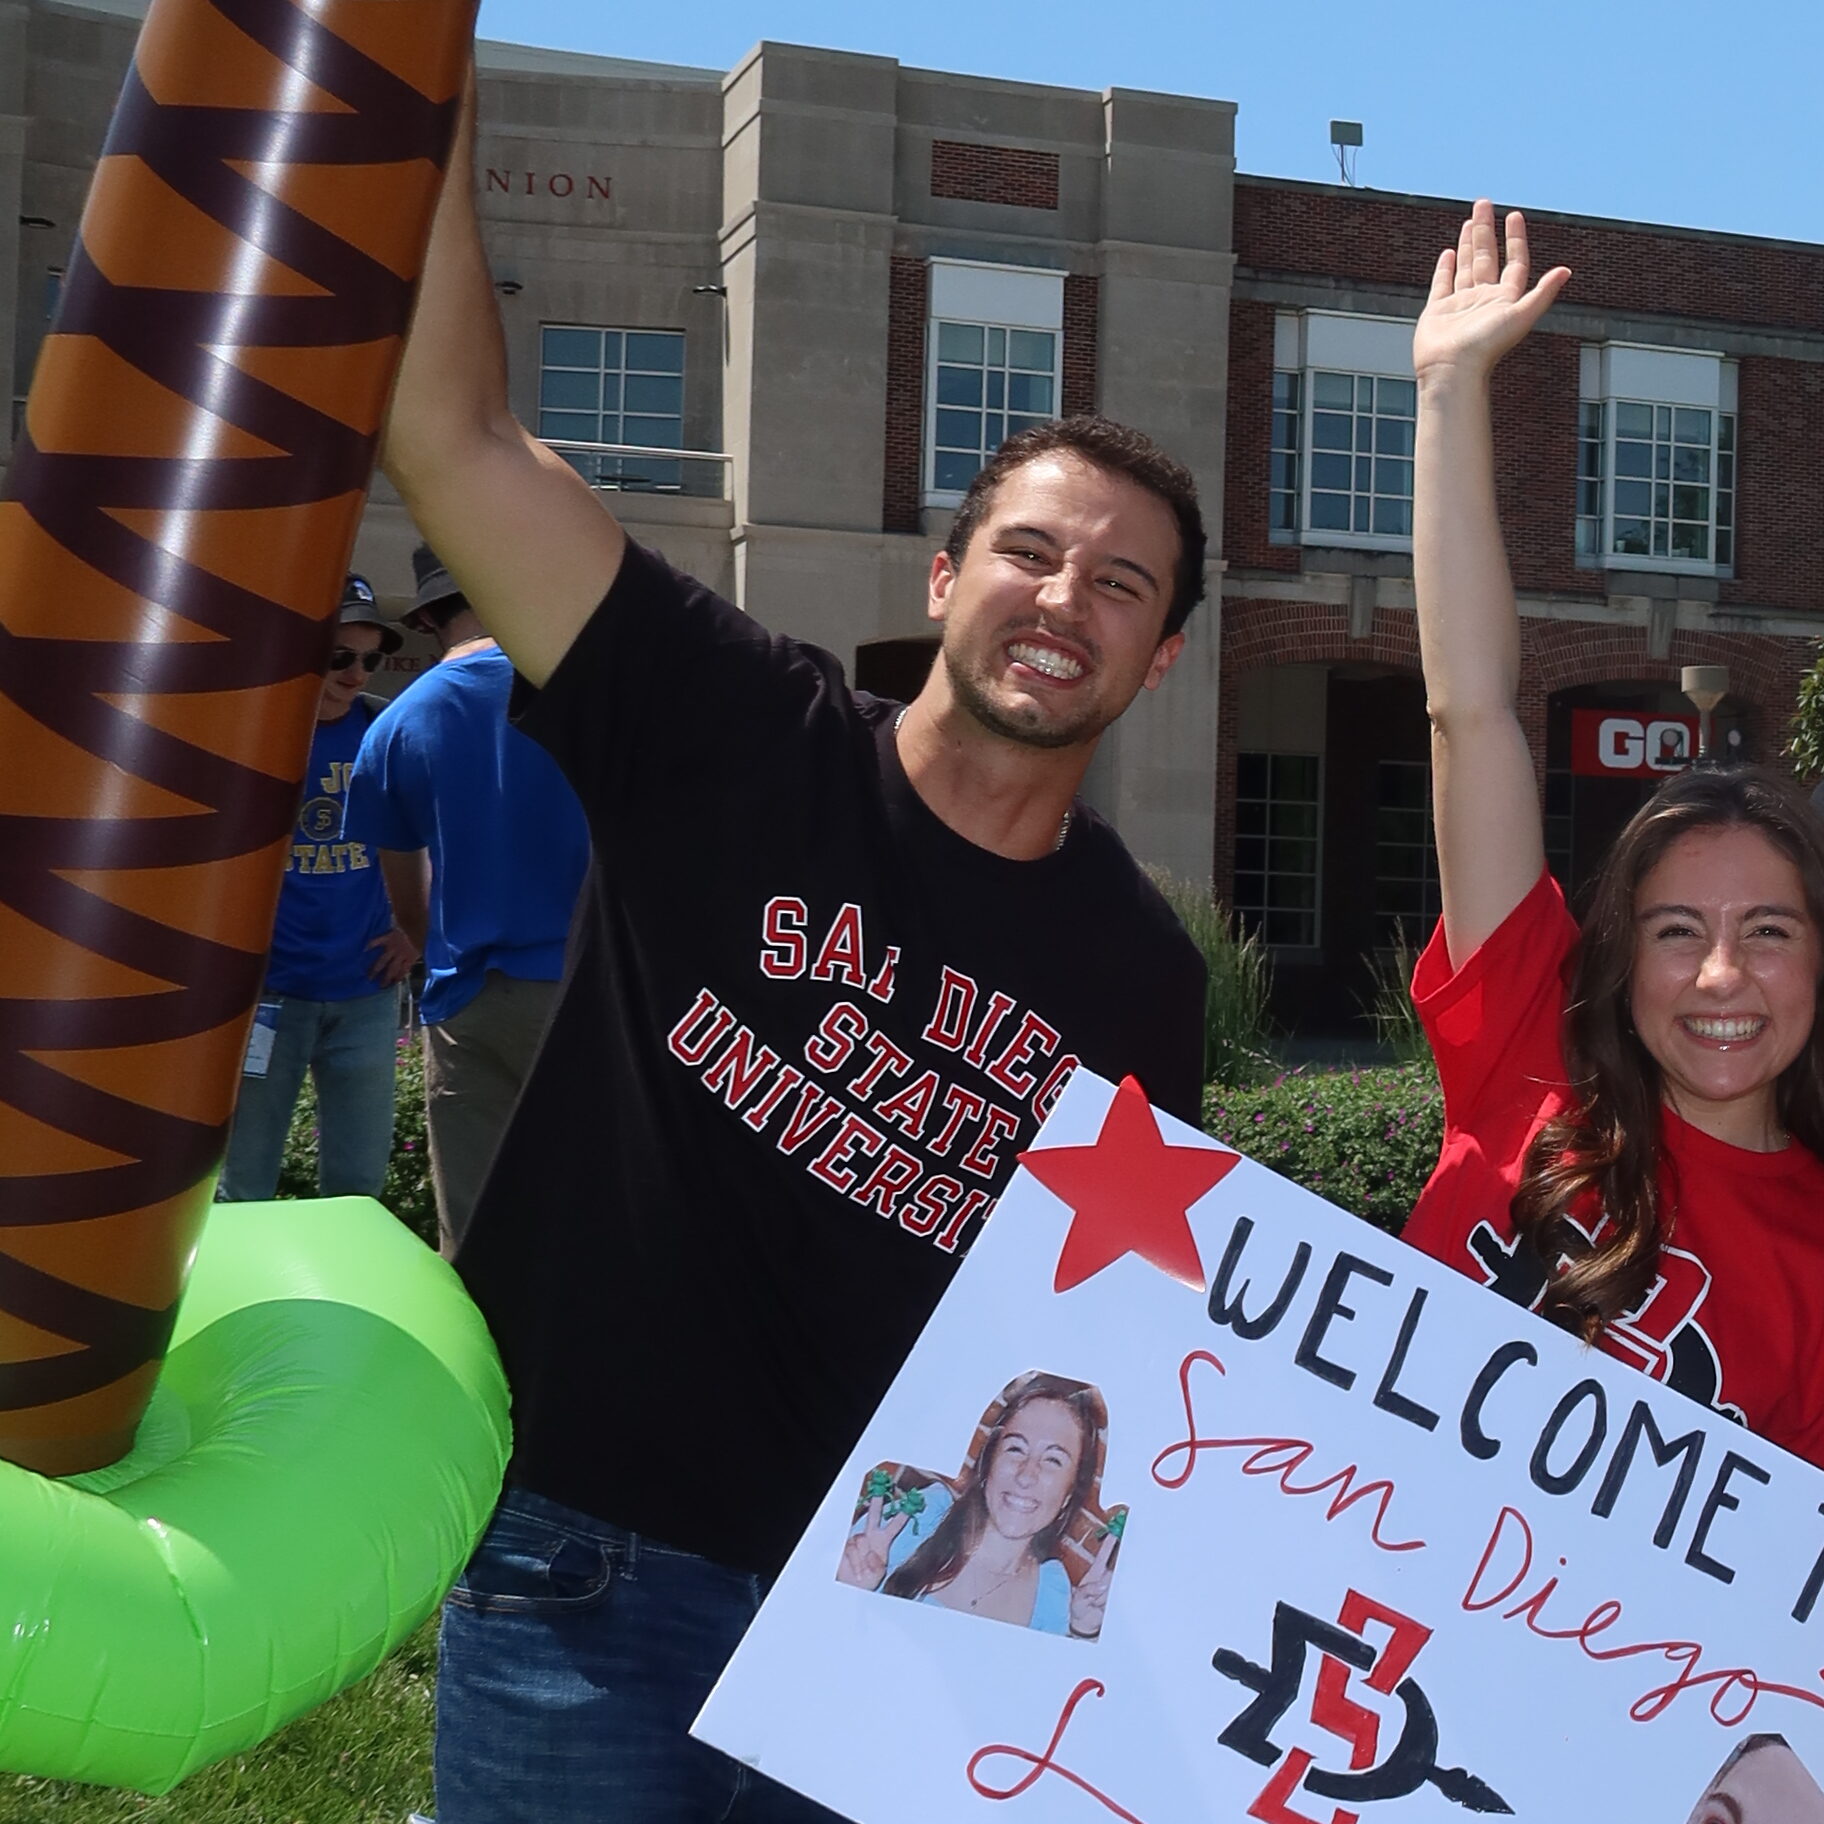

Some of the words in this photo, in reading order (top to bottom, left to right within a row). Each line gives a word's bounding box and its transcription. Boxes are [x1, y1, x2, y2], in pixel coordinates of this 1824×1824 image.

[1598, 718, 1691, 771] GO
[667, 987, 1000, 1255] UNIVERSI
[803, 1001, 1021, 1180] STATE
[1150, 1350, 1427, 1551] San
[1207, 1215, 1772, 1586] WELCOME
